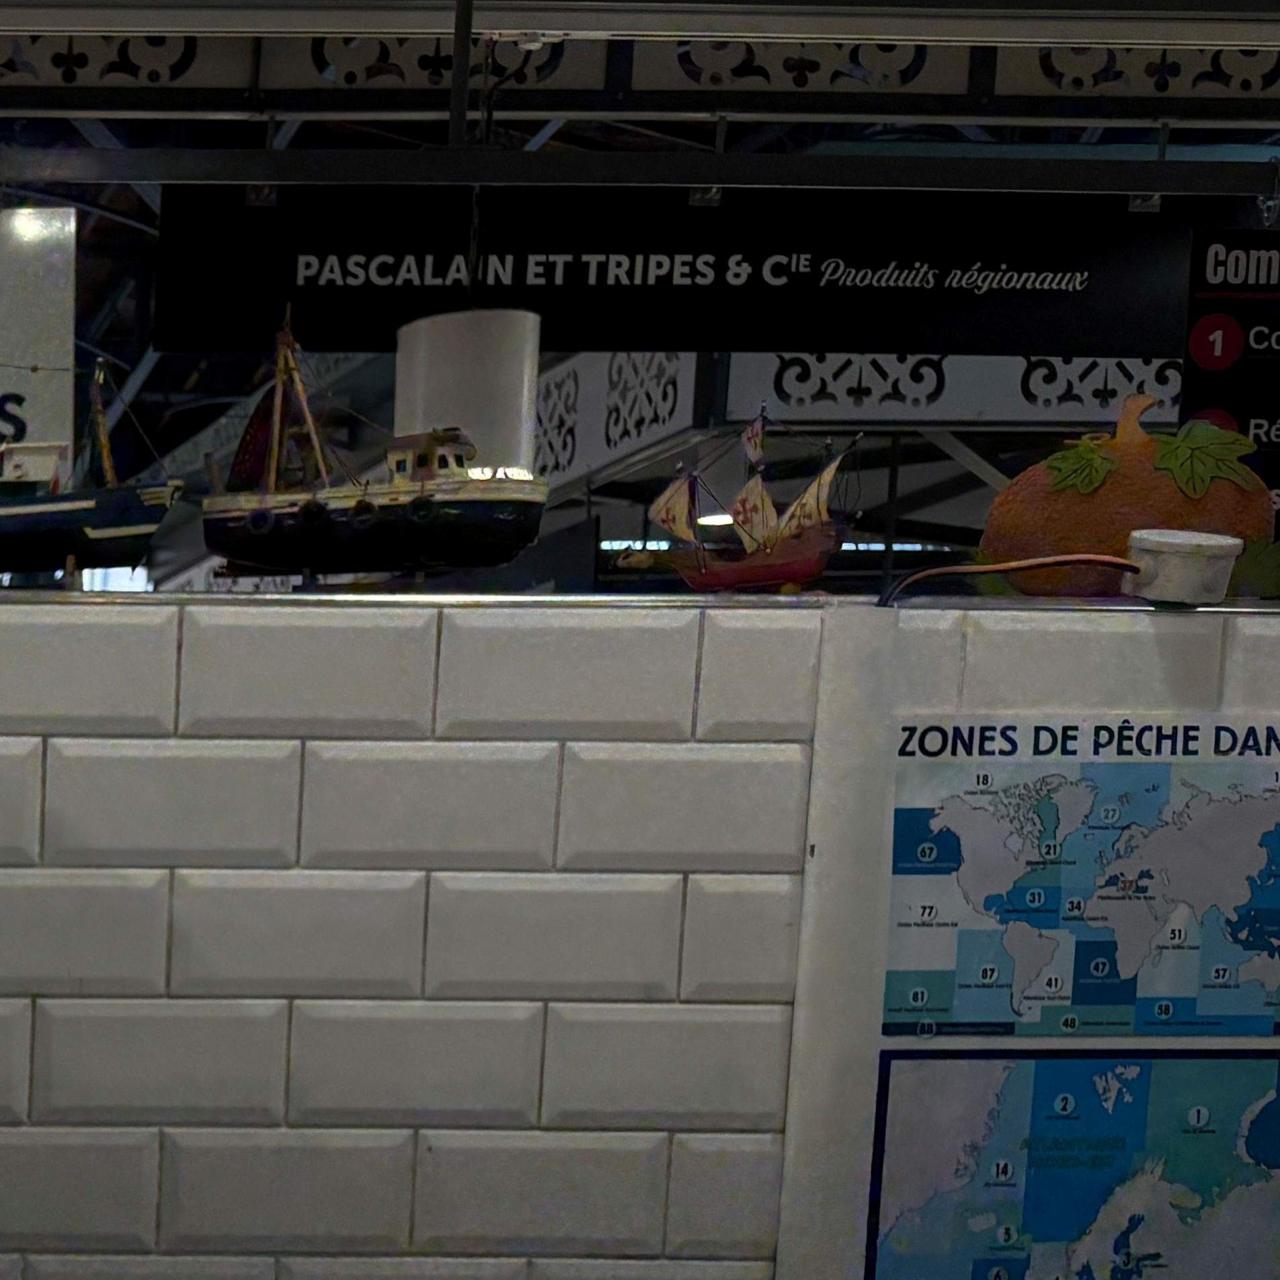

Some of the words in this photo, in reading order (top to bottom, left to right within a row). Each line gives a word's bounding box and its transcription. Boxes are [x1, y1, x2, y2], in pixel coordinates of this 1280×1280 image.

[525, 254, 574, 287] ET
[581, 254, 717, 288] TRIPES
[725, 253, 752, 287] &
[819, 256, 938, 290] Produits
[944, 262, 1090, 297] régionaux
[1208, 328, 1224, 358] 1
[897, 725, 1019, 758] ZONES
[1032, 725, 1079, 757] DE
[1092, 719, 1201, 758] PÊCHE
